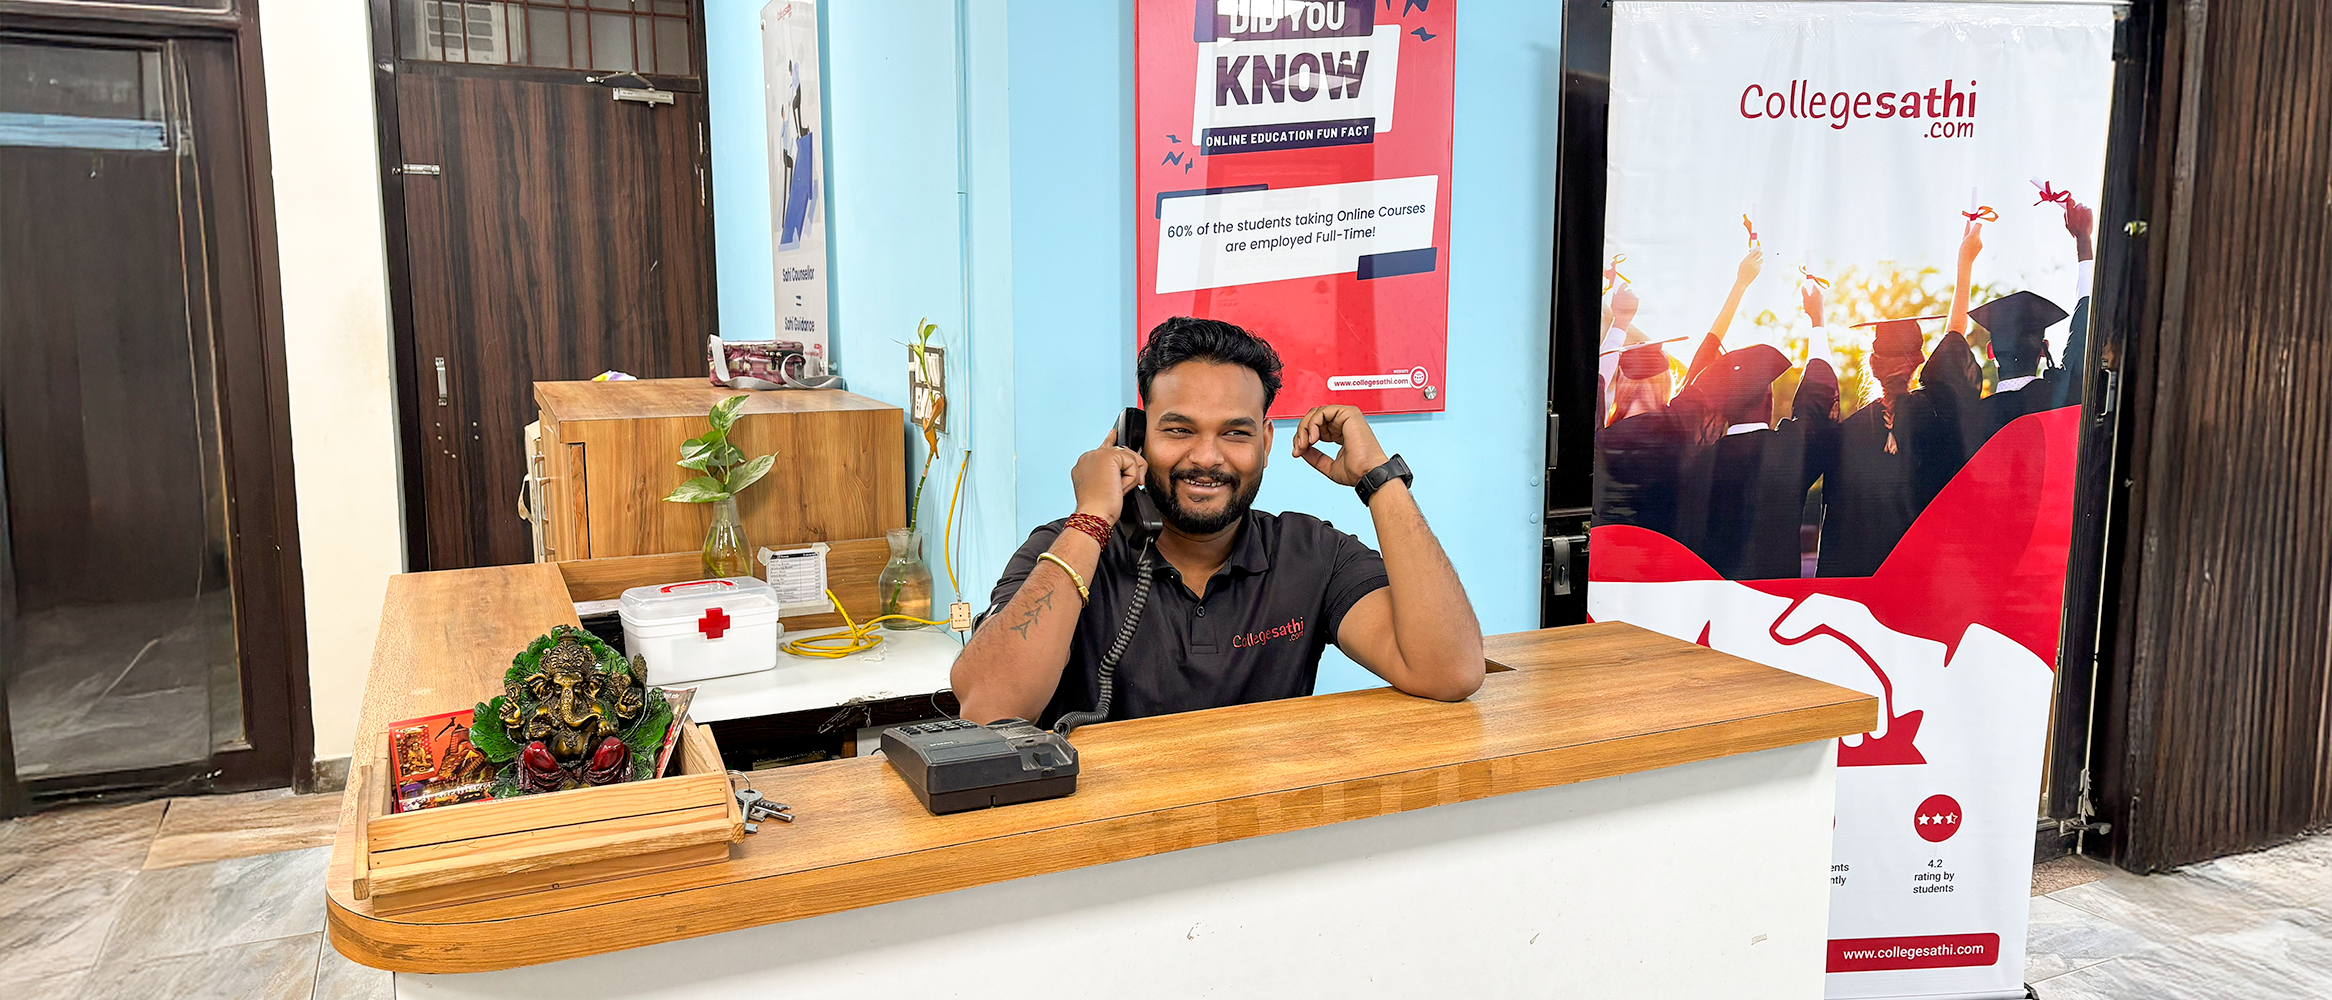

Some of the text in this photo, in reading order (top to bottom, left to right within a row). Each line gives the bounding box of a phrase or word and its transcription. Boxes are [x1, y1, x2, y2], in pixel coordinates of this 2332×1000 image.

[1287, 1, 1346, 32] YOU
[1215, 50, 1370, 107] KNOW
[1740, 79, 1977, 130] Collegesathi
[1206, 125, 1370, 147] ONLINE EDUCATION FUN FACT
[1923, 121, 1975, 138] .com
[1167, 204, 1426, 238] 60% of the students taking Online Courses
[1225, 226, 1376, 252] are employed Full-Time!
[1334, 378, 1409, 387] www.collegesathi.com
[1232, 616, 1304, 648] Collegesathi
[1289, 631, 1304, 642] .com
[1927, 859, 1943, 868] 4.2
[1914, 872, 1955, 882] rating by
[1912, 885, 1954, 894] students
[1843, 944, 1984, 960] www.collegesathi.com
